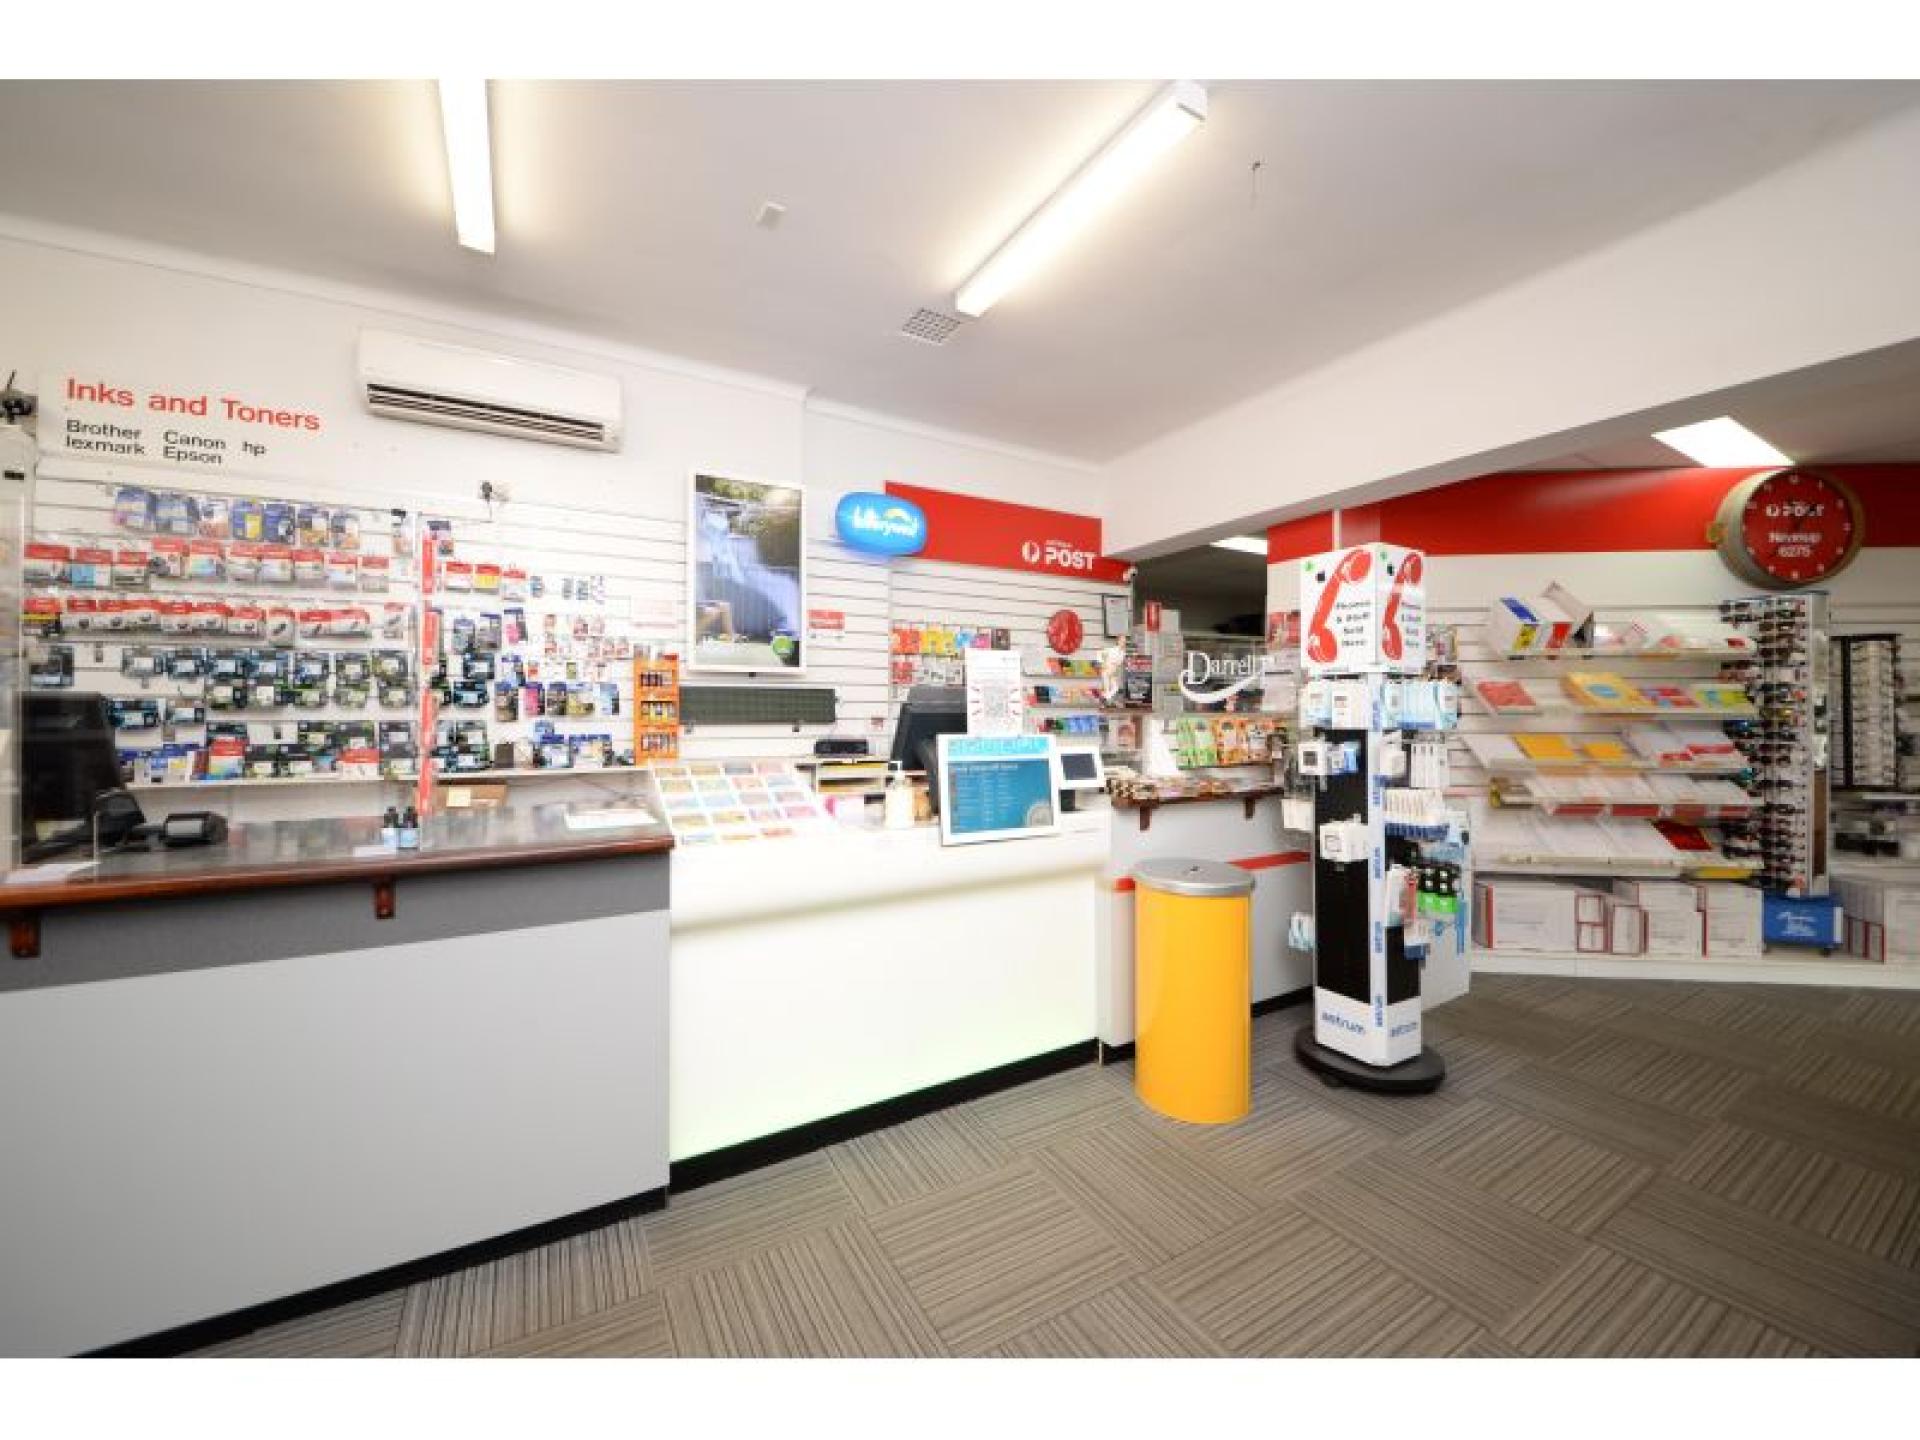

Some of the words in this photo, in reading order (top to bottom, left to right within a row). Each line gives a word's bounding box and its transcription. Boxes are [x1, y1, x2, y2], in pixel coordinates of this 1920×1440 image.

[66, 378, 134, 407] Inks
[149, 394, 208, 416] and
[221, 398, 321, 431] Toners
[66, 419, 142, 440] Brother
[163, 429, 226, 450] Canon
[242, 440, 267, 457] hp
[66, 434, 145, 456] lexmark
[163, 445, 222, 465] Epson
[1044, 546, 1095, 570] POST
[1321, 1010, 1365, 1035] astrum
